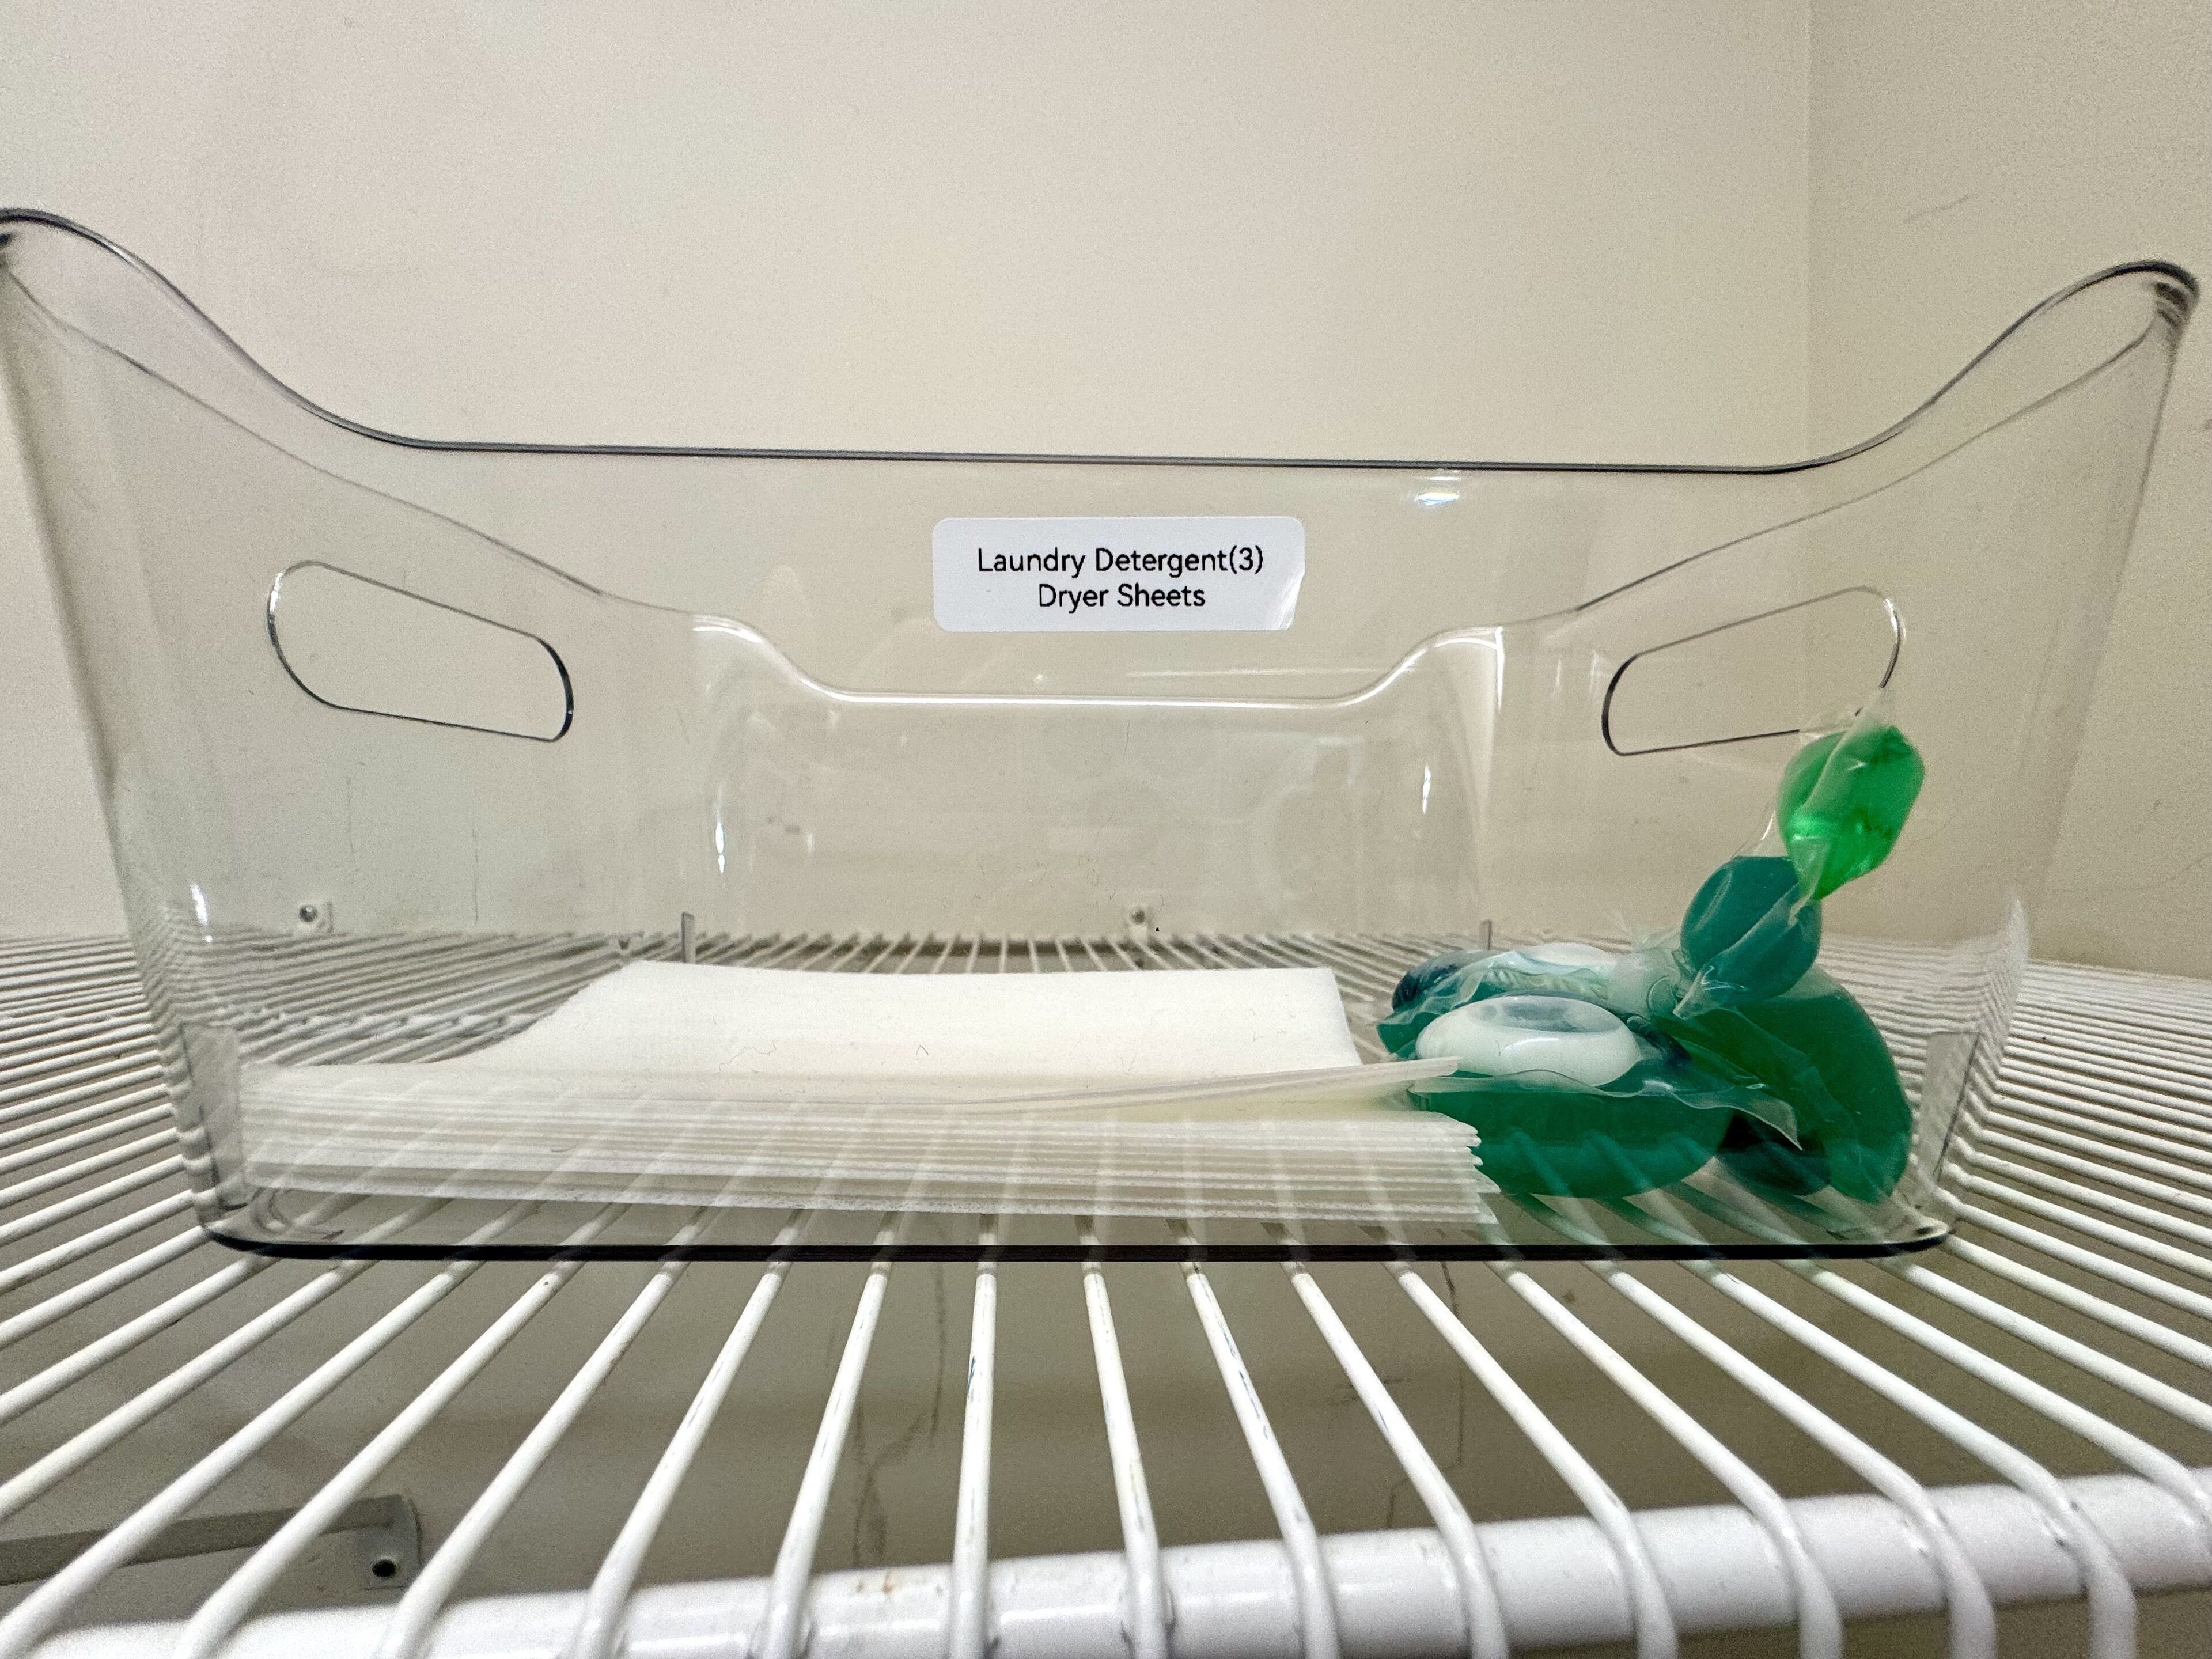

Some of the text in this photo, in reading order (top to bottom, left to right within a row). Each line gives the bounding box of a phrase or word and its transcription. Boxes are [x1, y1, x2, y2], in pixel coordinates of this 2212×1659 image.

[978, 544, 1264, 579] Laundry Detergent(3)
[1038, 582, 1206, 614] Dryer Sheets
